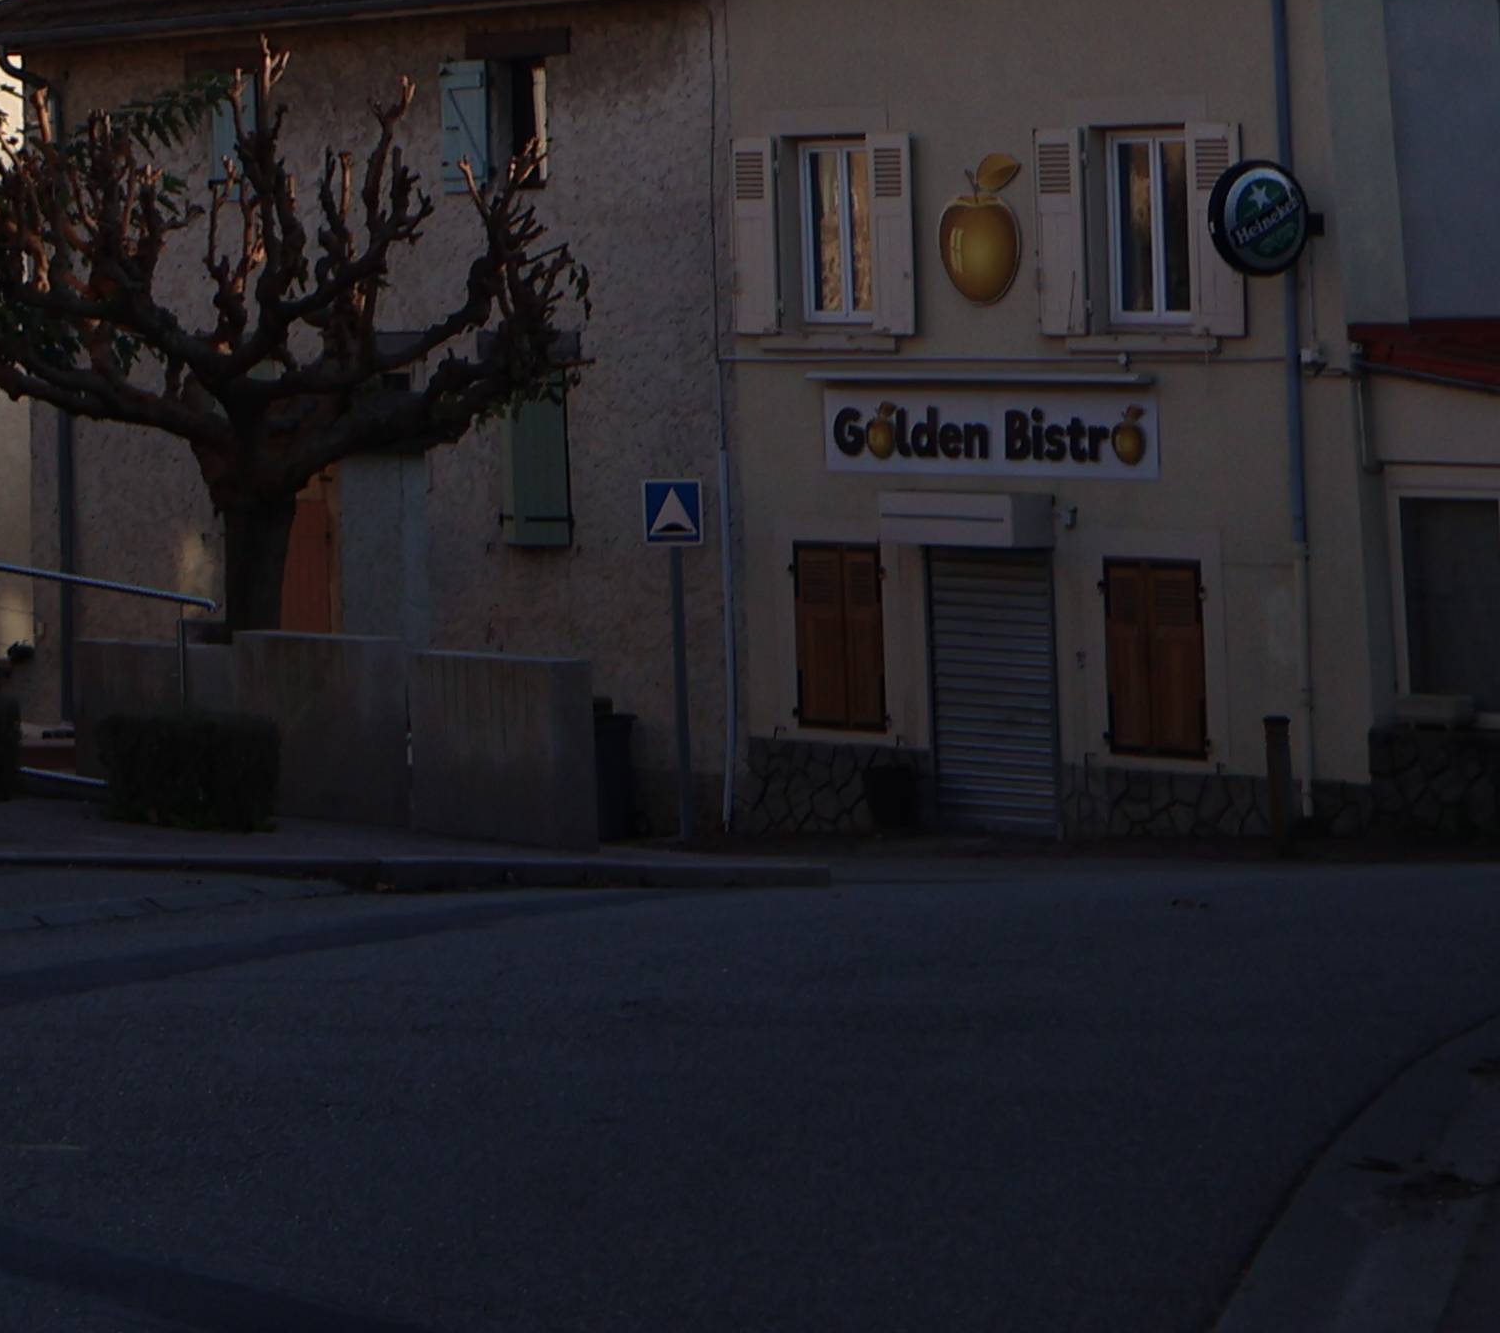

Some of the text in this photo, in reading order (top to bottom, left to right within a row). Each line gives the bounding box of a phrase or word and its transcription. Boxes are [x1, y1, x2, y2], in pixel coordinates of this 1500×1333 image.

[1235, 196, 1301, 245] Heineken
[833, 401, 1148, 466] Golden Bistro
